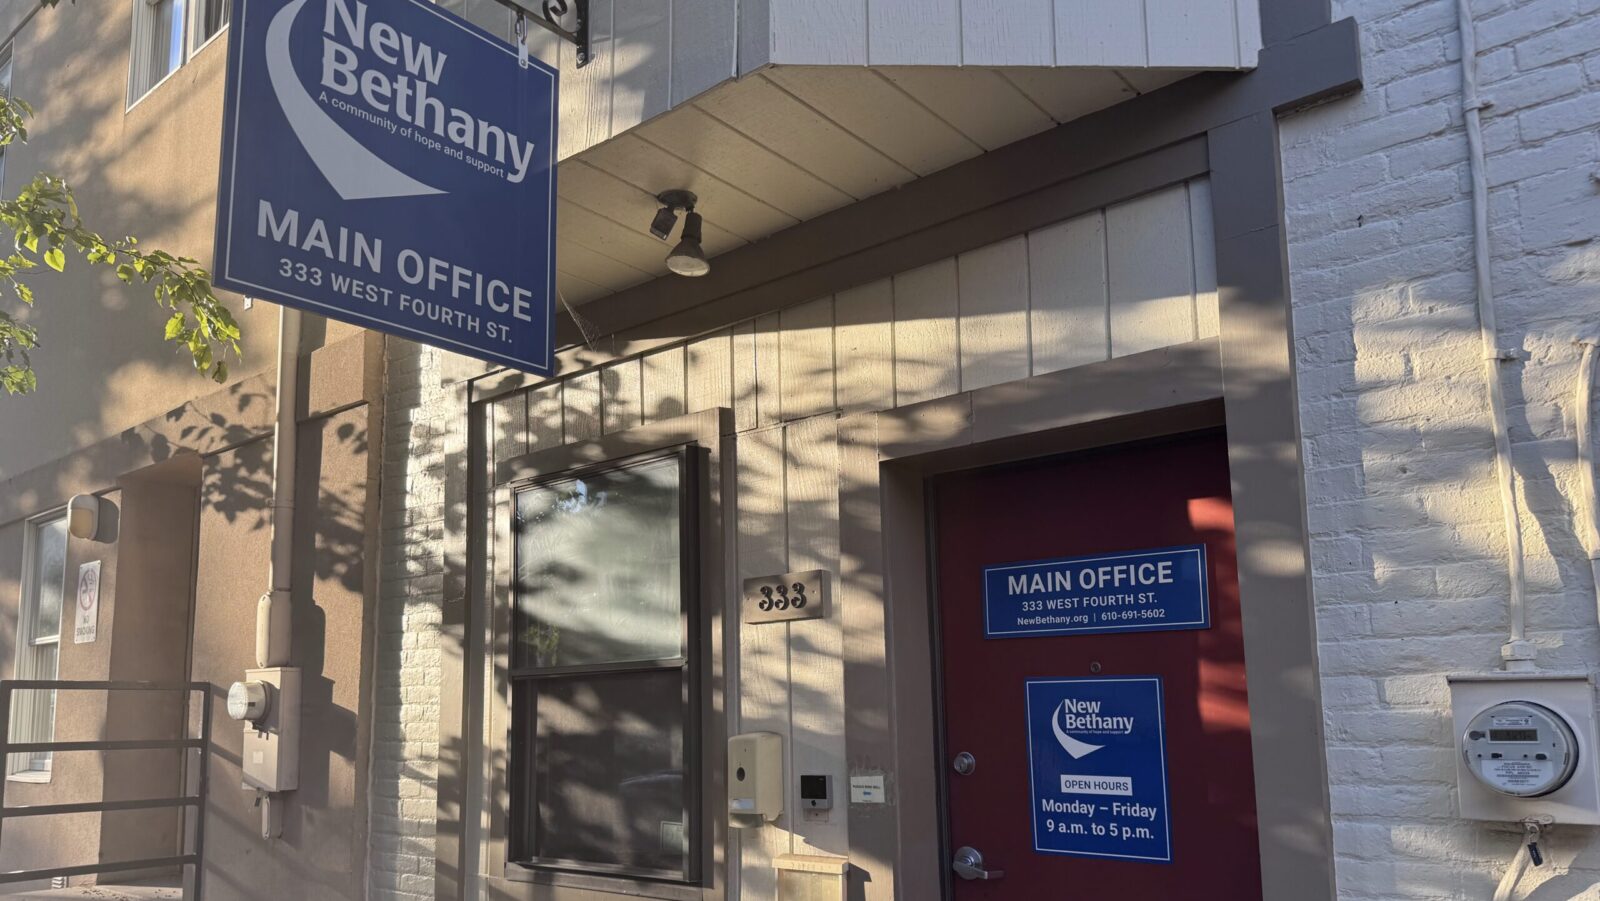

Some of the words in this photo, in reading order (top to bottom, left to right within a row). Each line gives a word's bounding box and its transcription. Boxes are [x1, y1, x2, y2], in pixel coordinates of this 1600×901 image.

[323, 0, 448, 86] New
[321, 36, 535, 184] Bethany
[318, 91, 328, 103] A
[331, 98, 398, 134] community
[400, 127, 412, 138] of
[414, 131, 442, 151] hope
[444, 146, 463, 160] and
[465, 155, 505, 178] support
[257, 199, 382, 273] MAIN
[397, 249, 533, 321] OFFICE
[279, 258, 322, 286] 333
[330, 272, 393, 306] WEST
[400, 295, 480, 334] FOURTH
[486, 321, 513, 343] ST.
[1008, 570, 1072, 595] MAIN
[1079, 561, 1174, 590] OFFICE
[759, 582, 807, 611] 333
[1022, 600, 1043, 612] 333
[1046, 597, 1080, 610] WEST
[1083, 593, 1134, 608] FOURTH
[1138, 592, 1158, 604] ST.
[1017, 613, 1089, 626] NewBethany.org
[1101, 608, 1166, 621] 610-691-5602
[1064, 698, 1101, 713] New
[1066, 714, 1134, 734] Bethany
[1064, 780, 1091, 790] OPEN
[1094, 780, 1129, 791] HOURS
[1042, 799, 1095, 817] Monday
[1112, 803, 1157, 821] Friday
[1046, 819, 1054, 832] 9
[1058, 822, 1088, 834] a.m.
[1091, 822, 1105, 835] to
[1109, 823, 1118, 836] 5
[1122, 827, 1154, 840] p.m.
